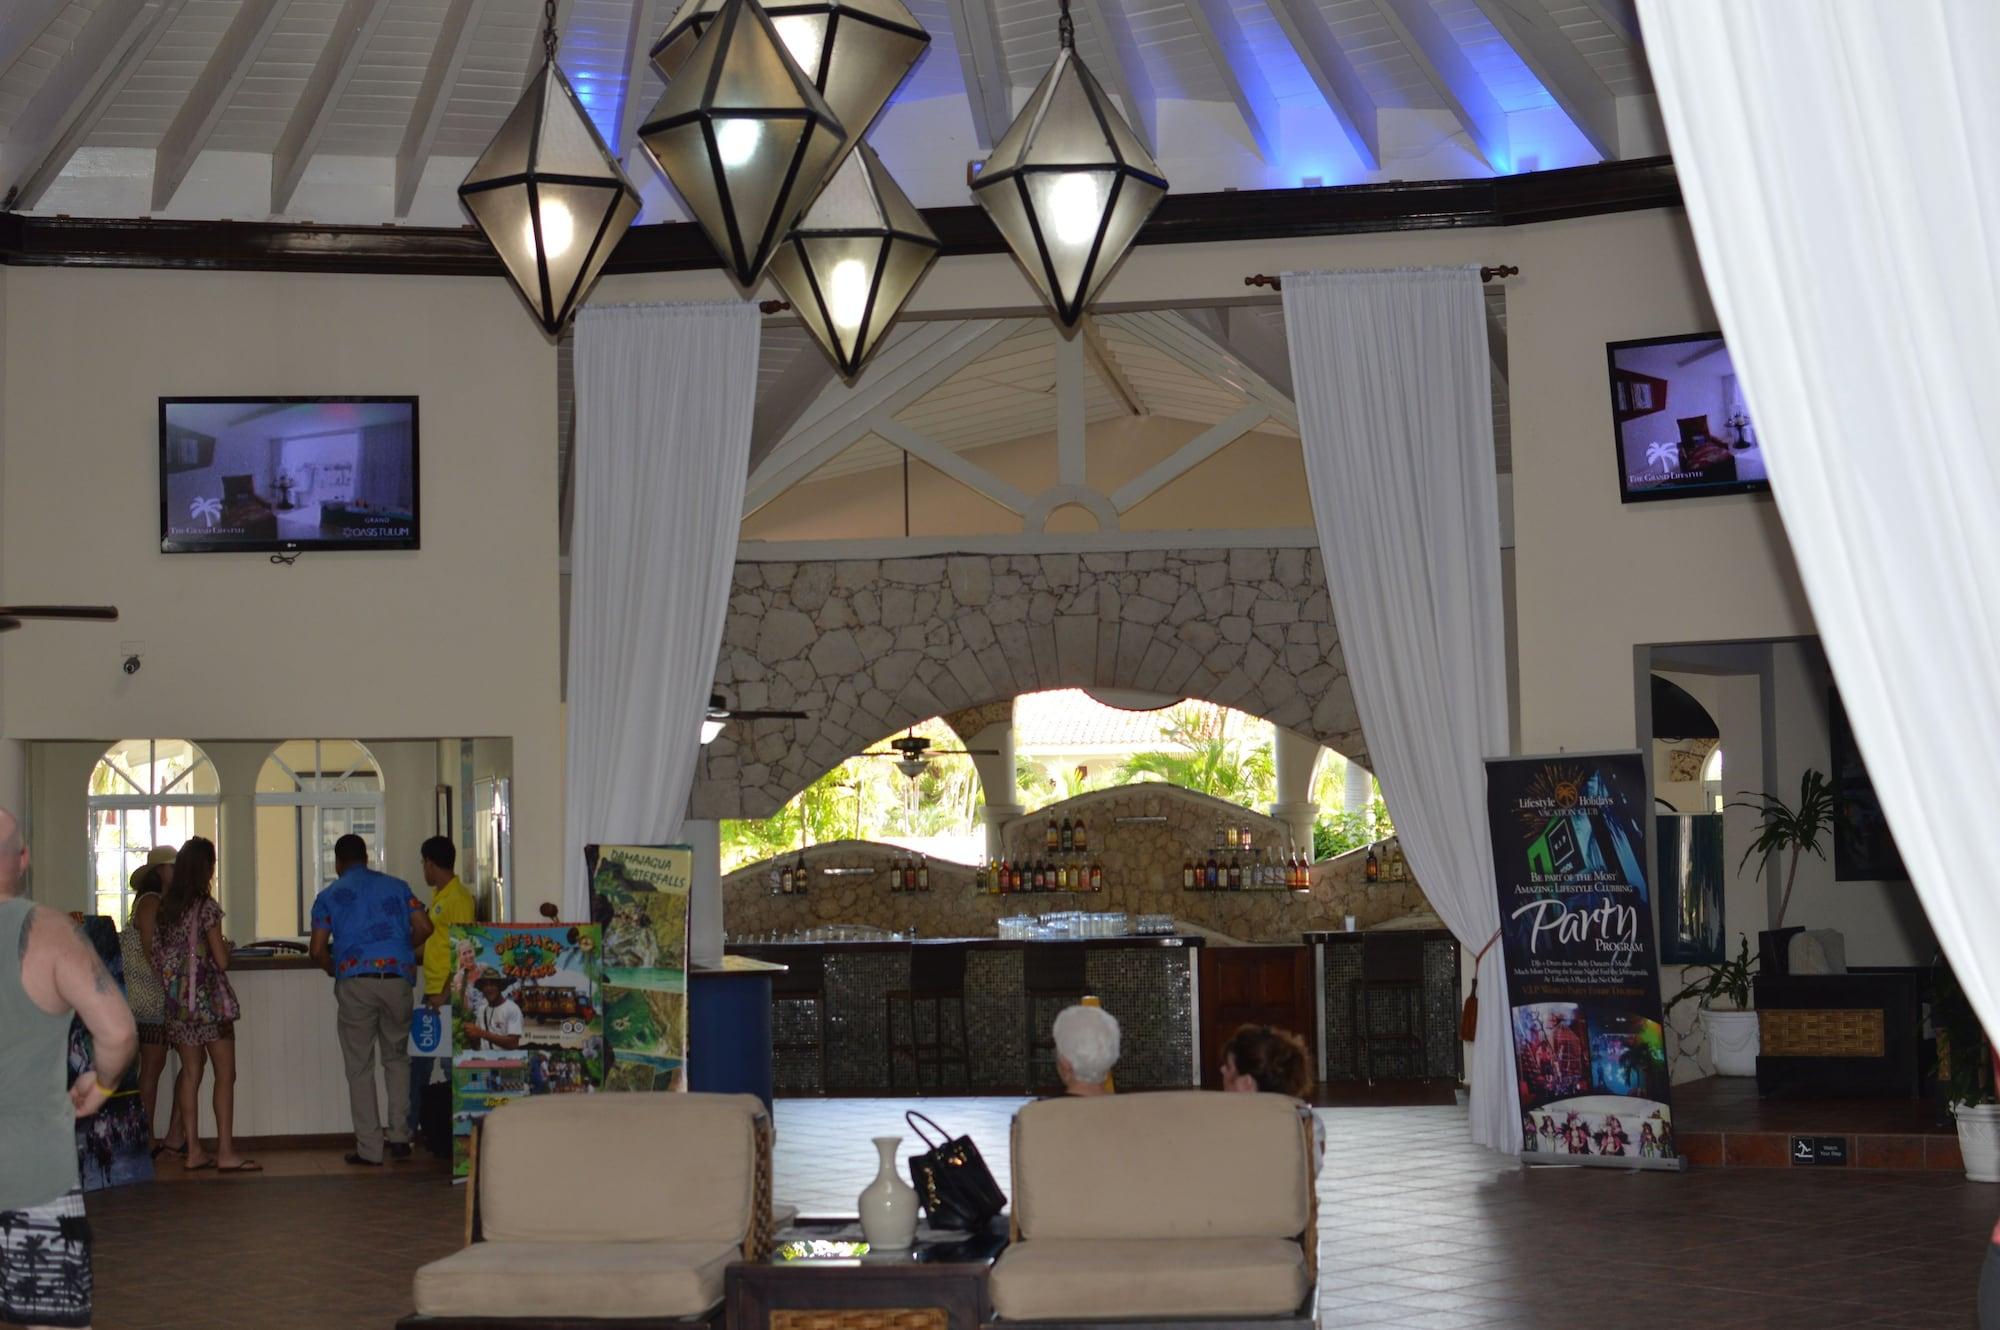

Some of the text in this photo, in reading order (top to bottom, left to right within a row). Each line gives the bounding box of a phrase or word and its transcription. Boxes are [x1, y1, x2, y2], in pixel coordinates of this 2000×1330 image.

[1519, 796, 1614, 809] Lifestyle Holidays
[611, 849, 672, 871] DAMAJAGUA
[1512, 897, 1638, 963] Party
[420, 1014, 434, 1047] blue
